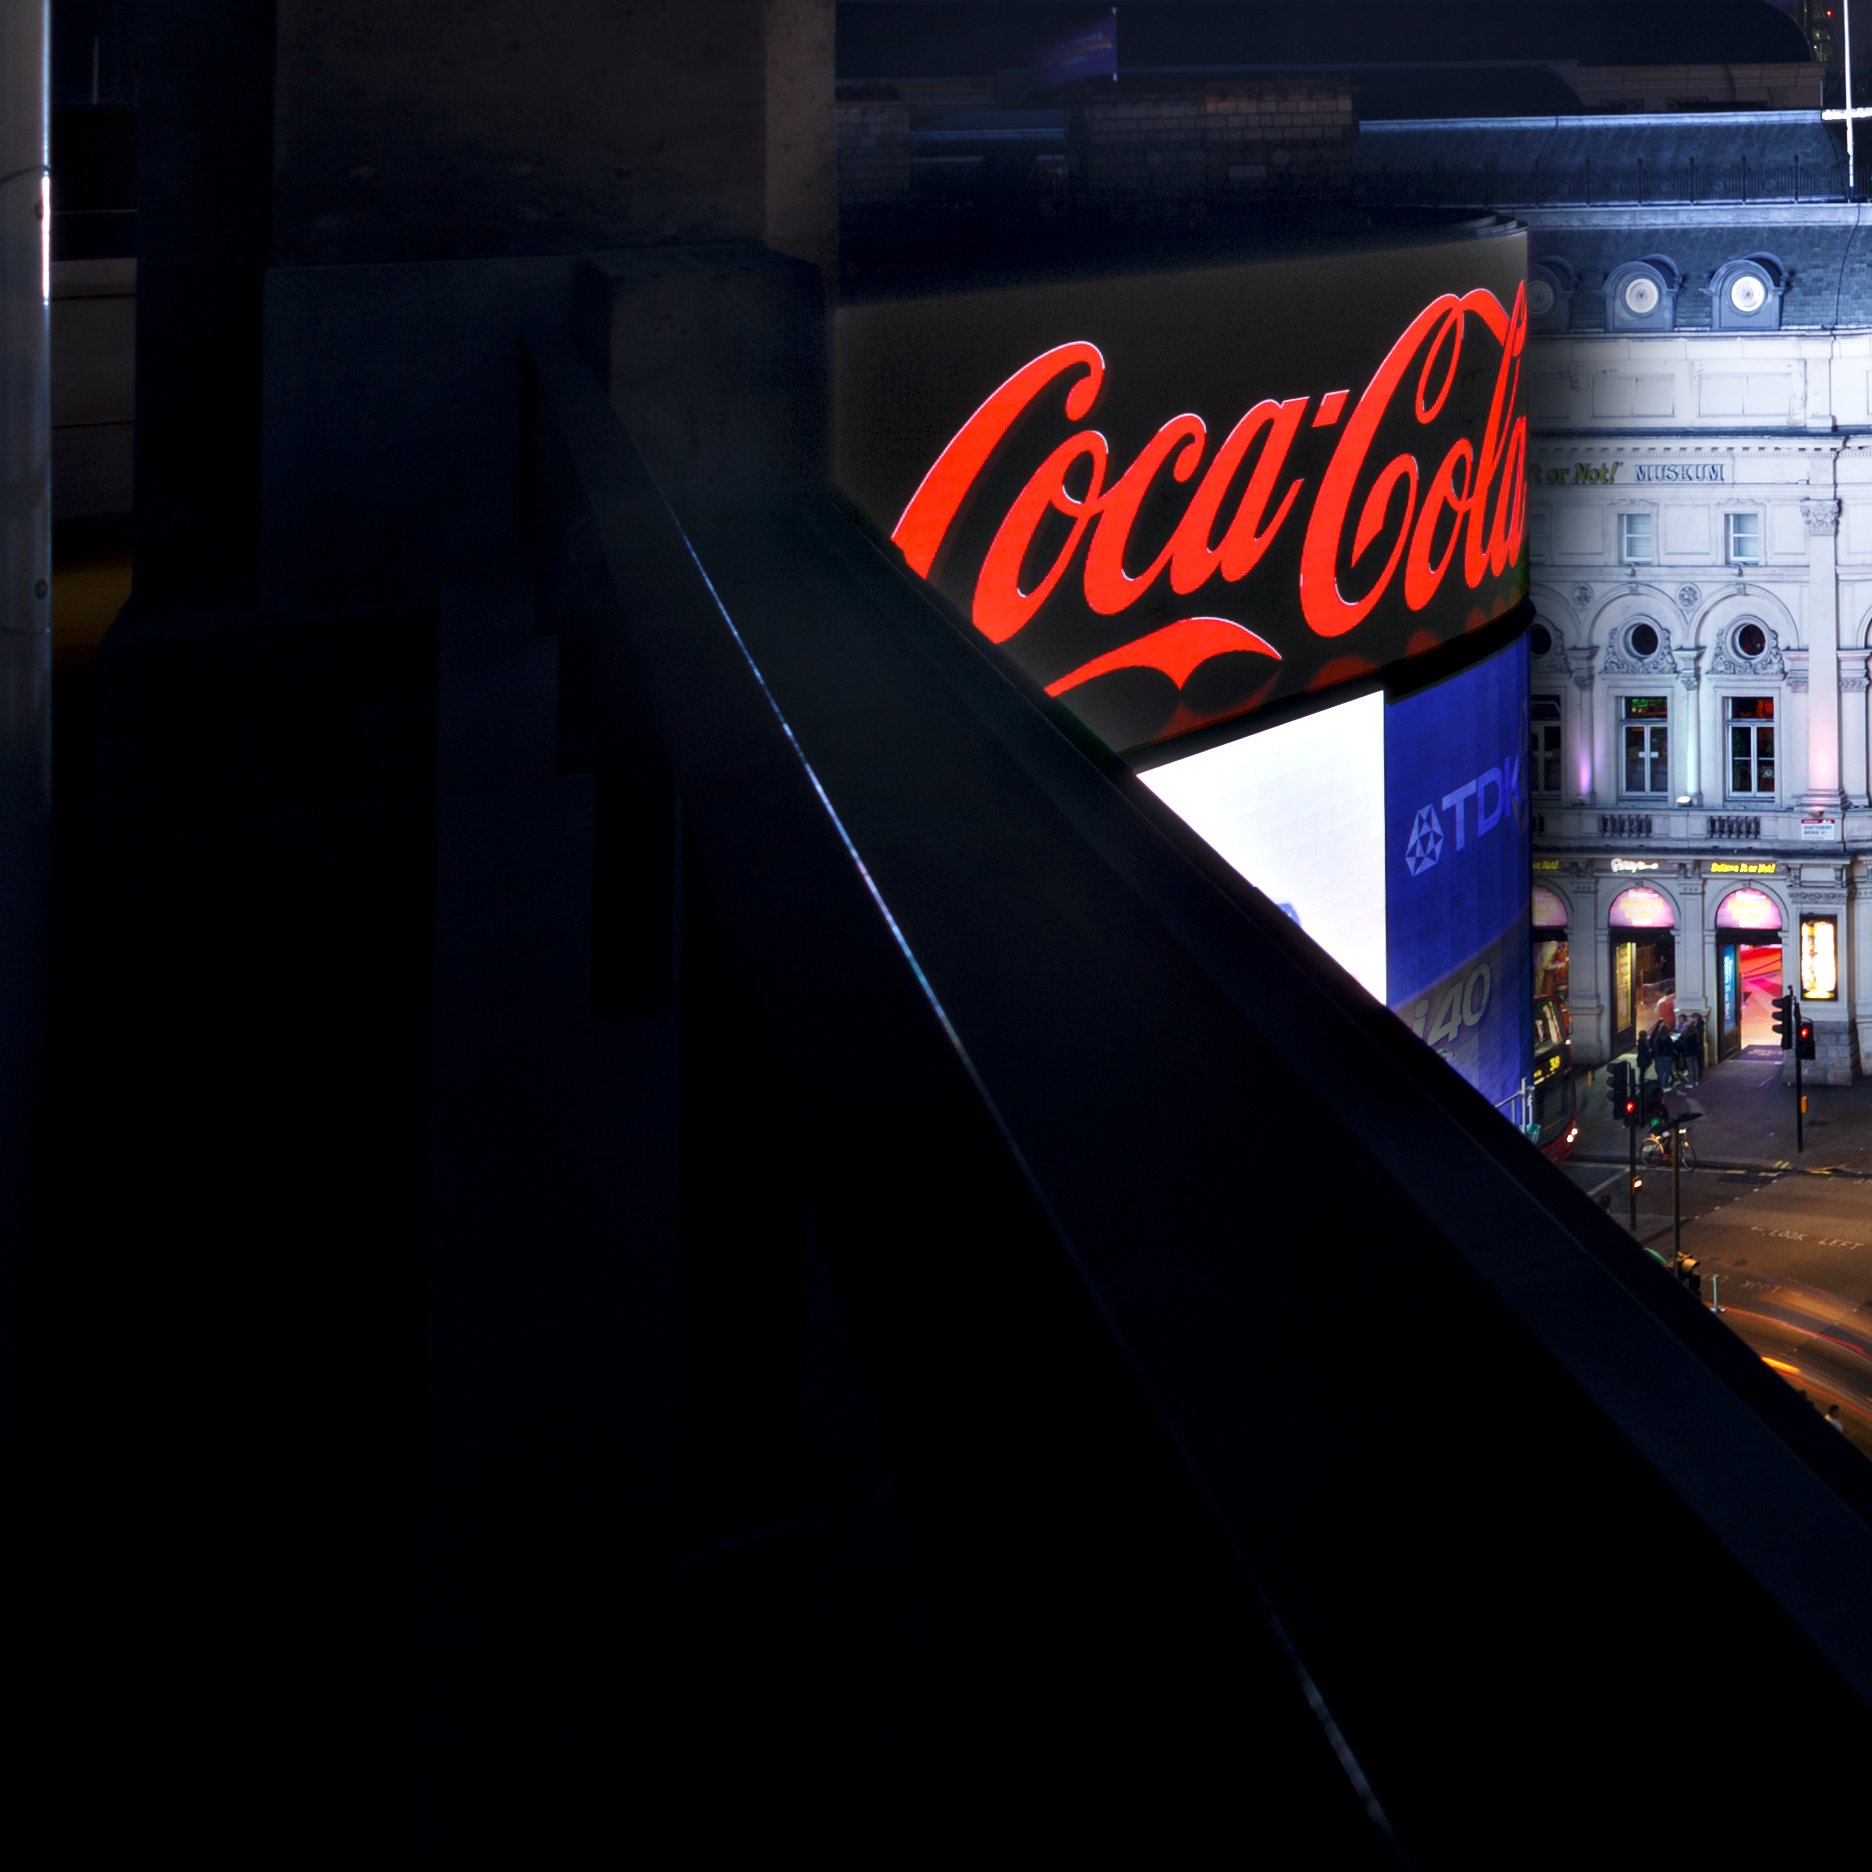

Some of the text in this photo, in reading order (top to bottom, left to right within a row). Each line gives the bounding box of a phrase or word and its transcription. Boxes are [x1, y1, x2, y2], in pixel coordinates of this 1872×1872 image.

[891, 280, 1527, 640] Coca-Cola
[1634, 464, 1724, 482] MUSEUM
[1442, 752, 1522, 851] TDK
[1413, 963, 1491, 1047] i40
[1818, 1236, 1864, 1250] LEFT
